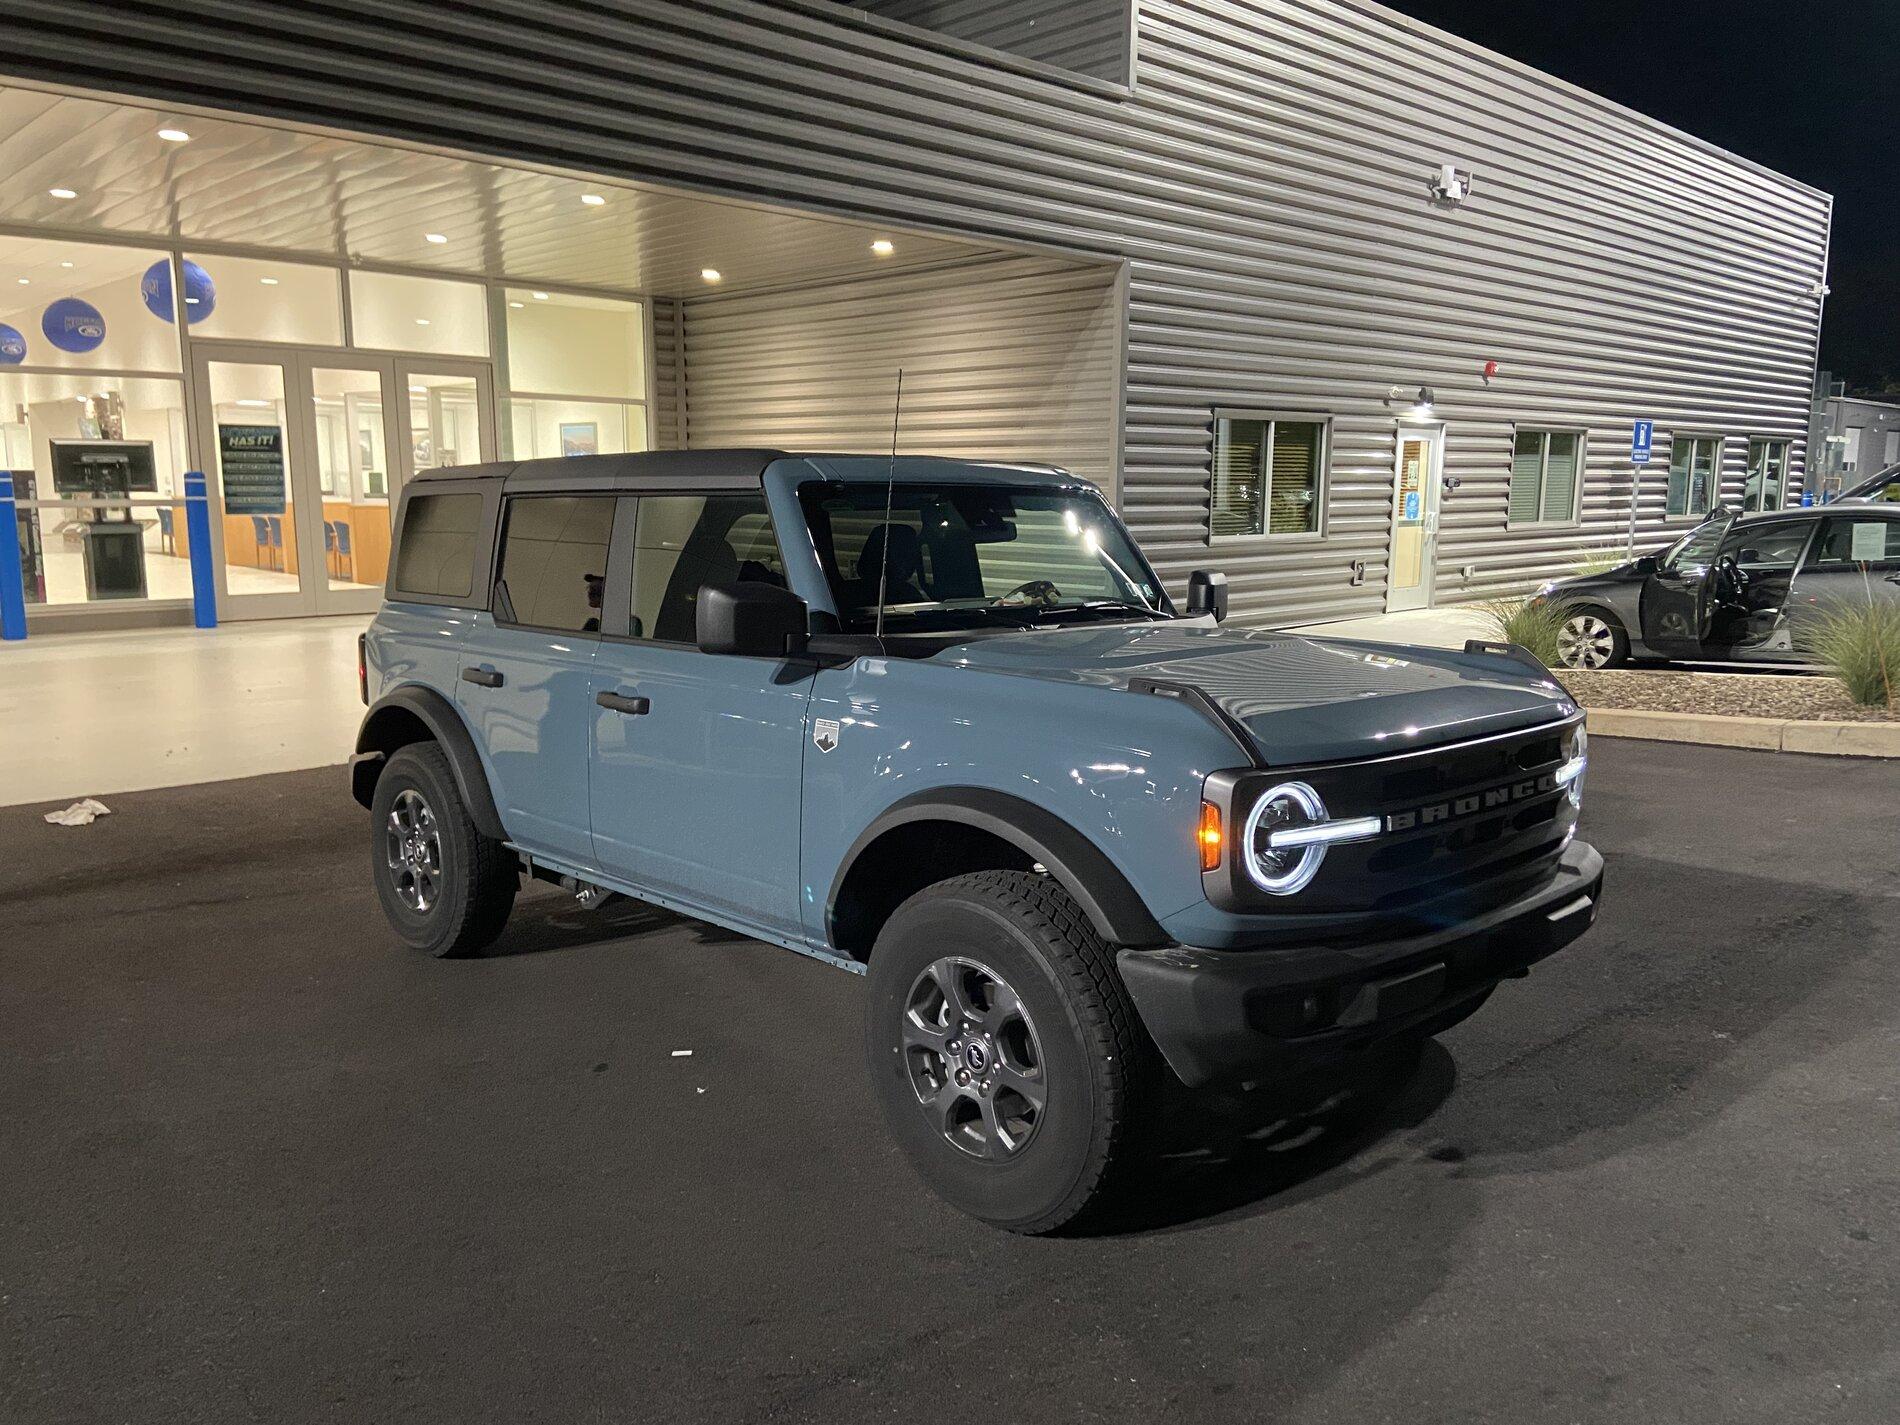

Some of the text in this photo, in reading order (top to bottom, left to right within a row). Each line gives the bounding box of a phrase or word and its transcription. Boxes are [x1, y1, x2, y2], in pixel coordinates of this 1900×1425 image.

[229, 435, 274, 446] HAS IT!
[1386, 776, 1556, 832] BRONCO
